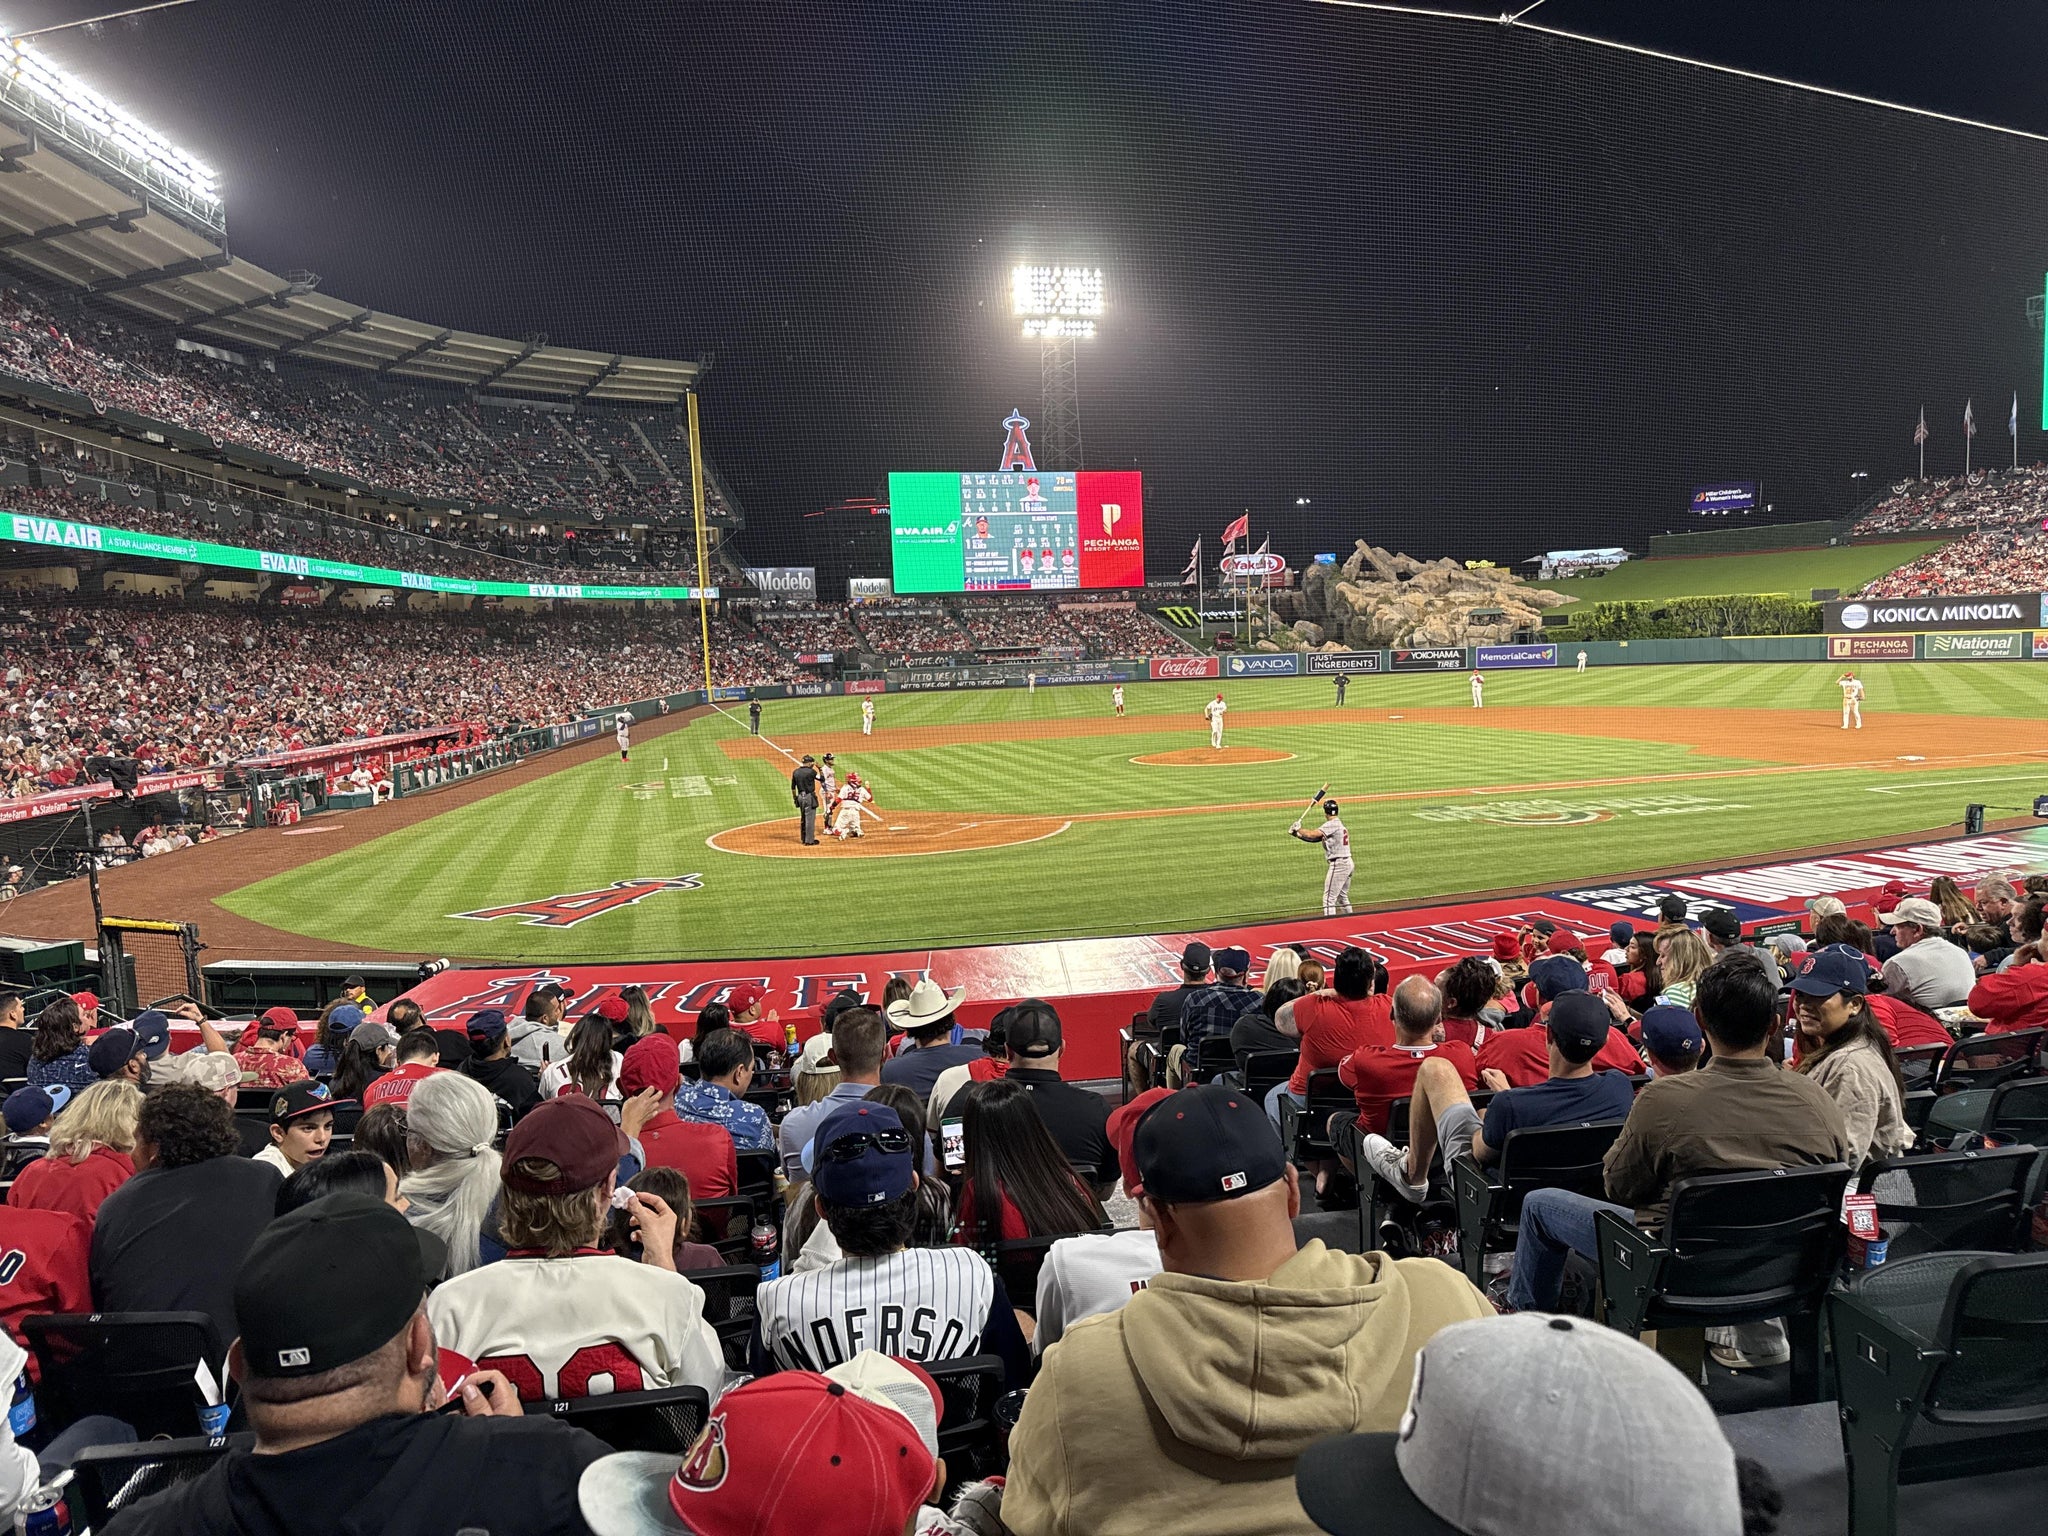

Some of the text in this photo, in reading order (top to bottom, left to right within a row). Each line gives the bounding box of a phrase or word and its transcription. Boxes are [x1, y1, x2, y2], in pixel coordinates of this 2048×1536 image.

[114, 538, 131, 548] STAR
[132, 541, 161, 553] ALLIANCE
[1084, 539, 1139, 547] PECHANGA
[758, 571, 811, 590] Modelo
[856, 581, 886, 594] Modelo
[1873, 604, 2022, 624] KONICA MINOLTA
[1853, 640, 1908, 648] PECHANGA
[1951, 636, 2013, 649] National
[1411, 650, 1460, 660] YOKOHAMA
[1480, 652, 1541, 662] MemorialCare
[1159, 659, 1208, 677] Coca-Cola
[1246, 659, 1293, 669] VANDA
[1314, 660, 1373, 669] INGREDIENTS
[1437, 660, 1460, 668] TIRES
[796, 685, 822, 695] Modelo
[1560, 884, 1661, 902] FRIDAY
[1589, 973, 1610, 991] OUT
[1620, 1250, 1627, 1262] K
[768, 1305, 980, 1375] NDERSO
[1869, 1345, 1877, 1363] L
[554, 1402, 569, 1412] 121
[209, 1437, 226, 1447] 121
